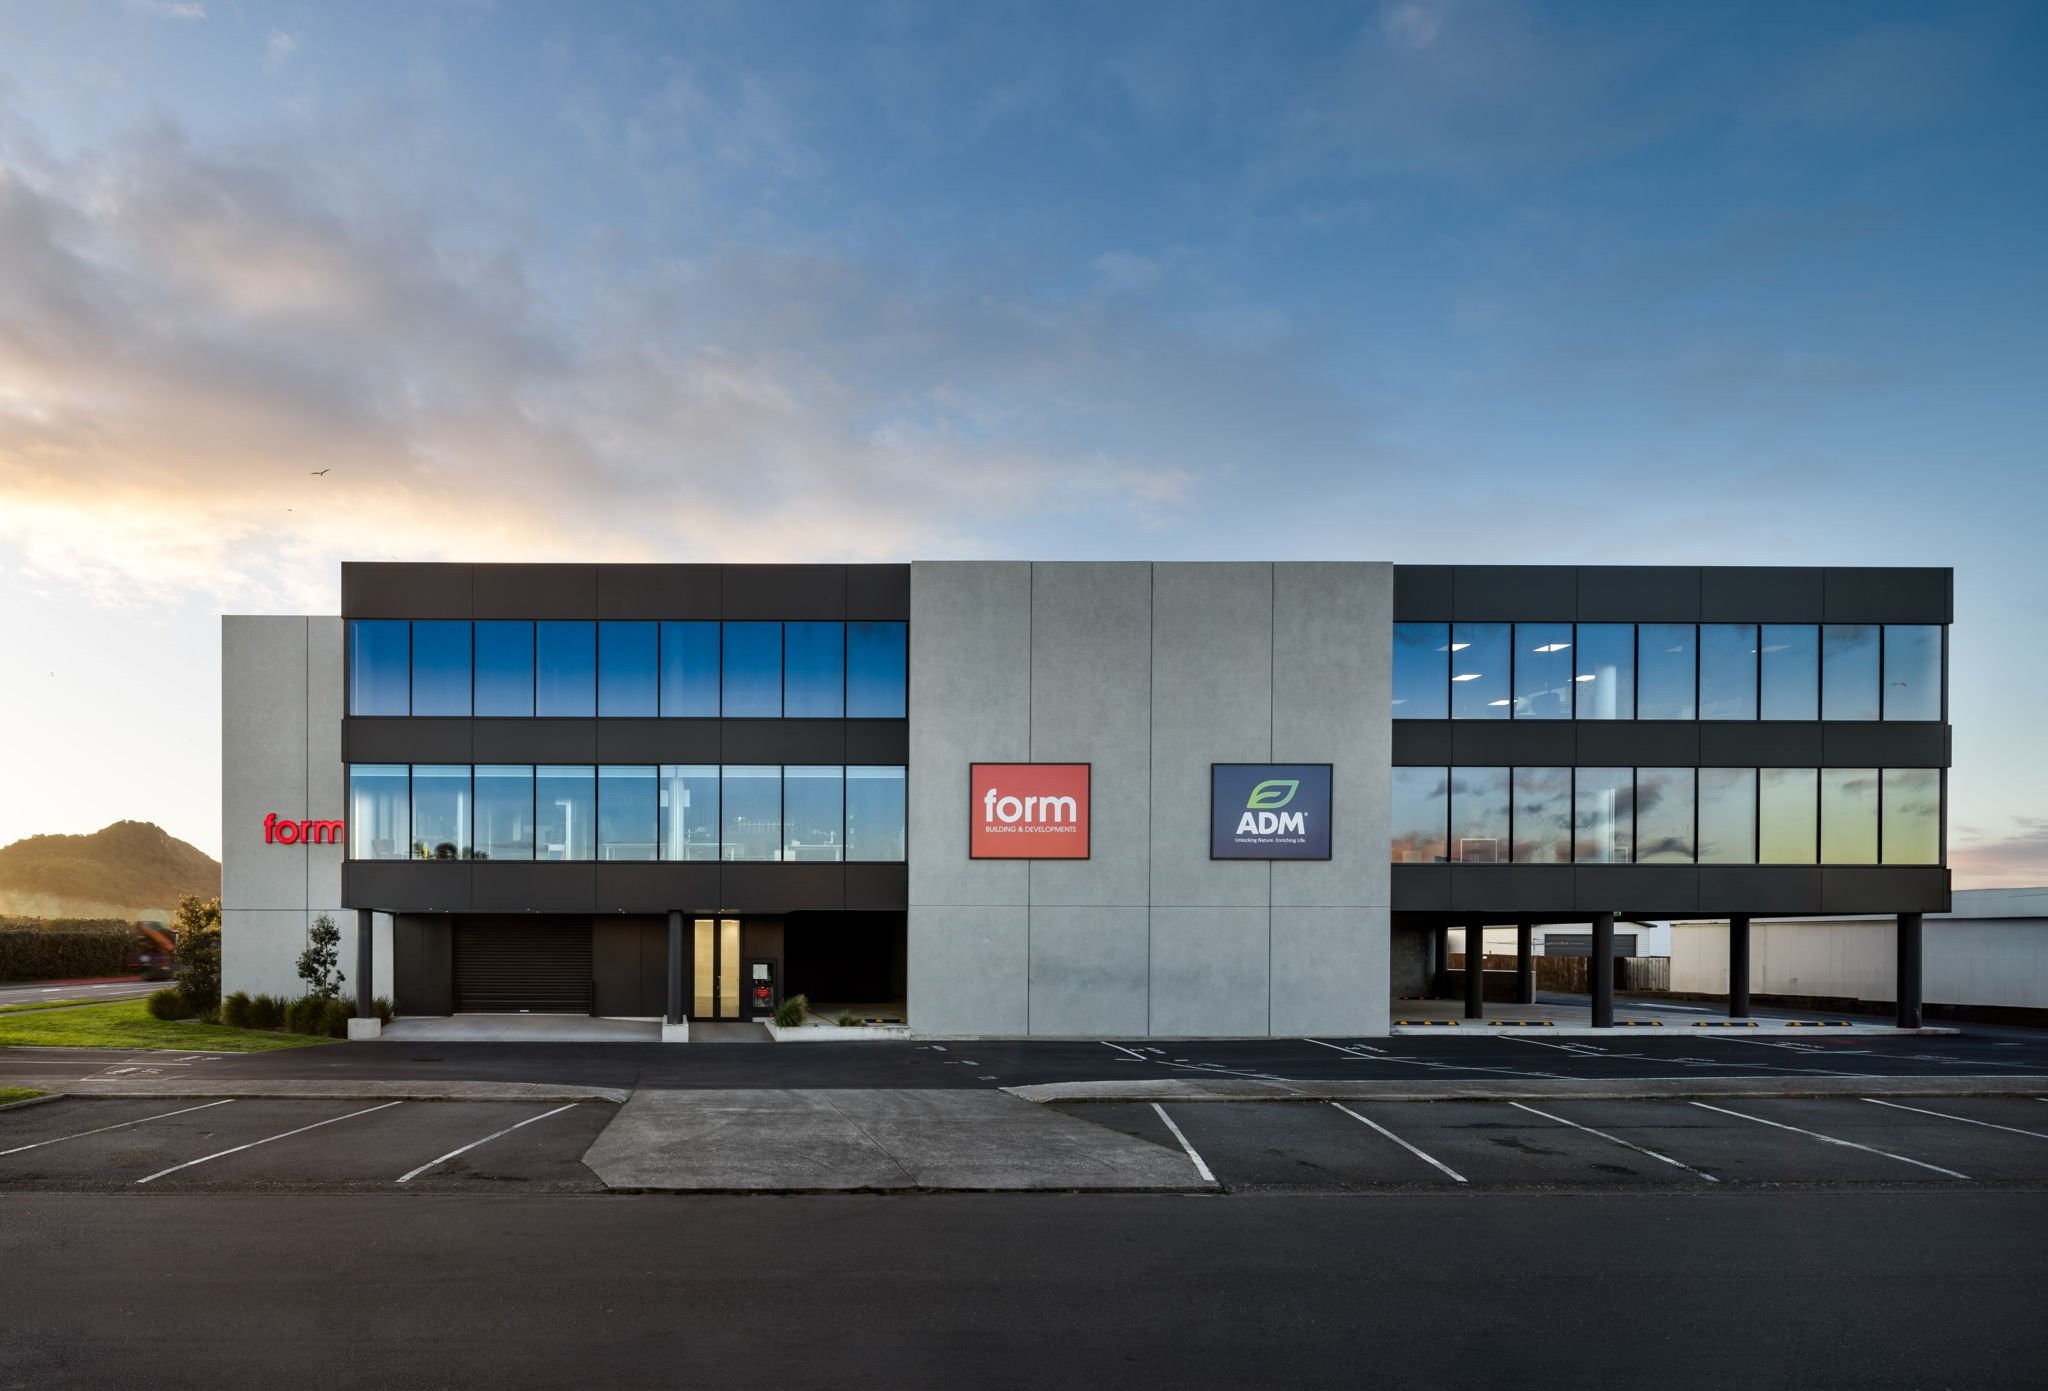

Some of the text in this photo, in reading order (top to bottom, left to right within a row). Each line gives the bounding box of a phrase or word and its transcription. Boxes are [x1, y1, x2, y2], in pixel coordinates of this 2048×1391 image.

[984, 787, 1077, 823] form
[263, 812, 345, 845] form
[985, 825, 1077, 833] BUILDING & DEVELOPMENTS
[1235, 811, 1305, 835] ADM
